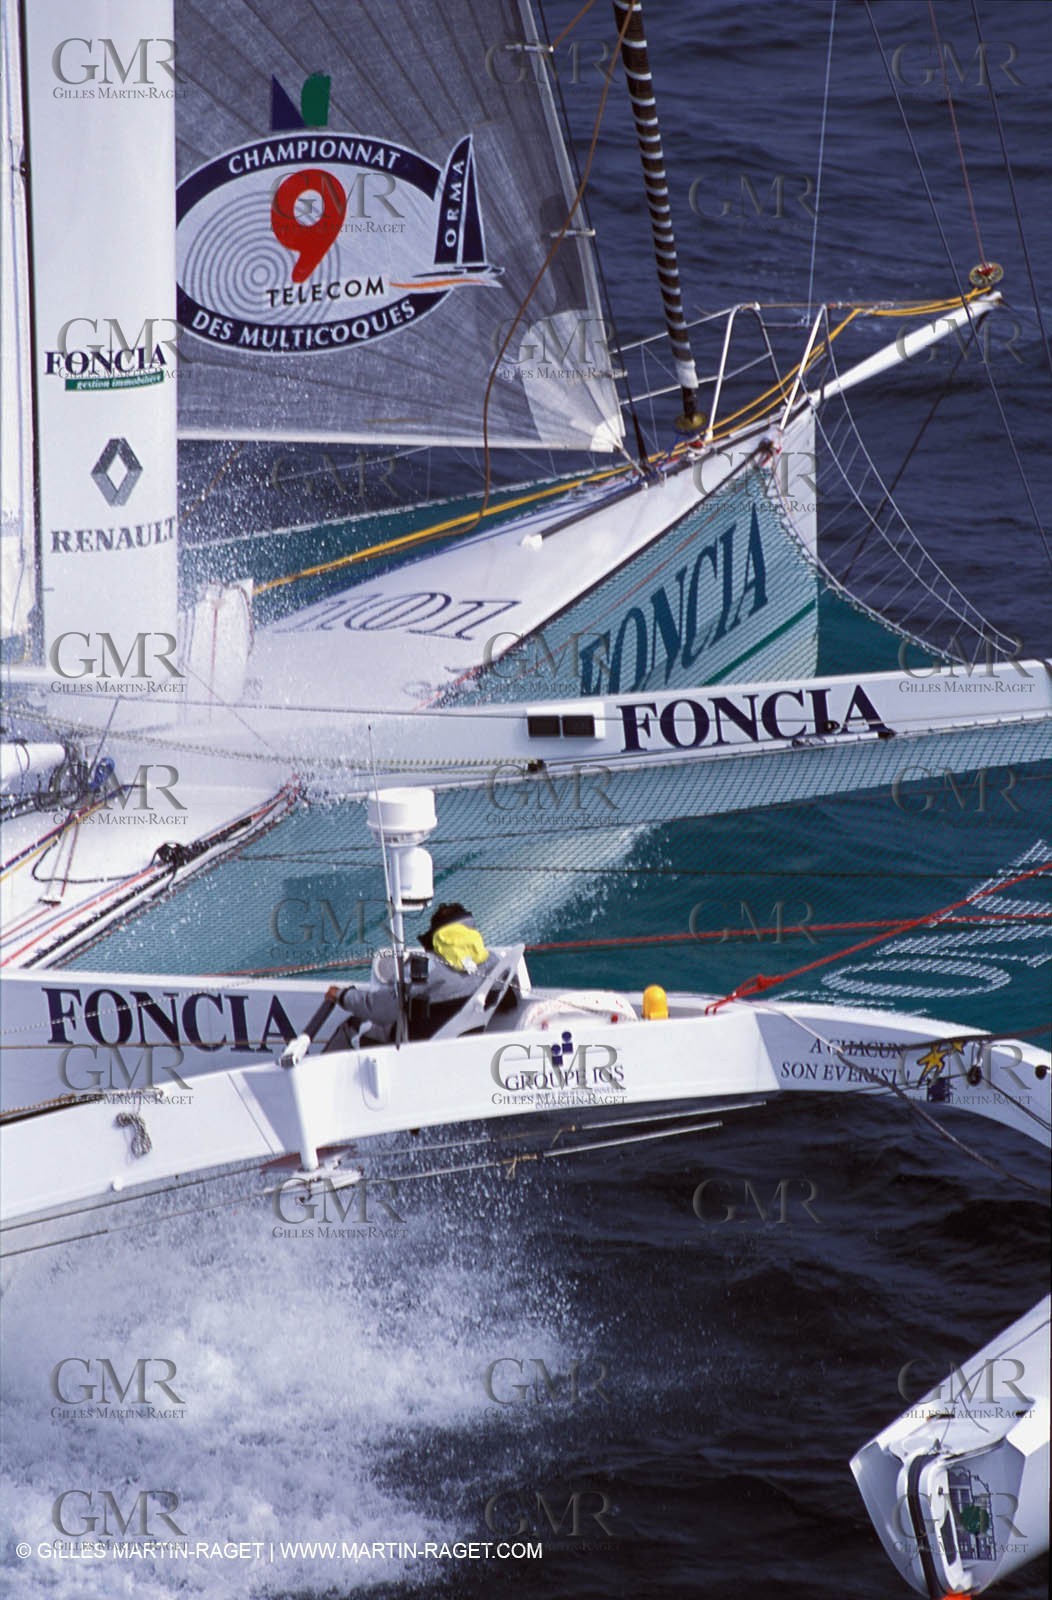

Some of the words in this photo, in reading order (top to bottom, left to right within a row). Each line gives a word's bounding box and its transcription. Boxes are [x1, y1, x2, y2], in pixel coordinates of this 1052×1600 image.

[228, 139, 400, 175] CHAMPIONNAT
[270, 168, 348, 284] 9
[443, 159, 465, 249] ORMA
[266, 275, 385, 309] TELECOM
[191, 310, 233, 341] DES
[239, 299, 416, 348] MULTICOQUES
[44, 343, 167, 376] FONCIA
[51, 515, 175, 553] RENAULT
[579, 502, 768, 698] FONCIA
[616, 684, 887, 753] FONCIA
[41, 987, 306, 1054] FONCIA
[780, 1061, 818, 1079] SON
